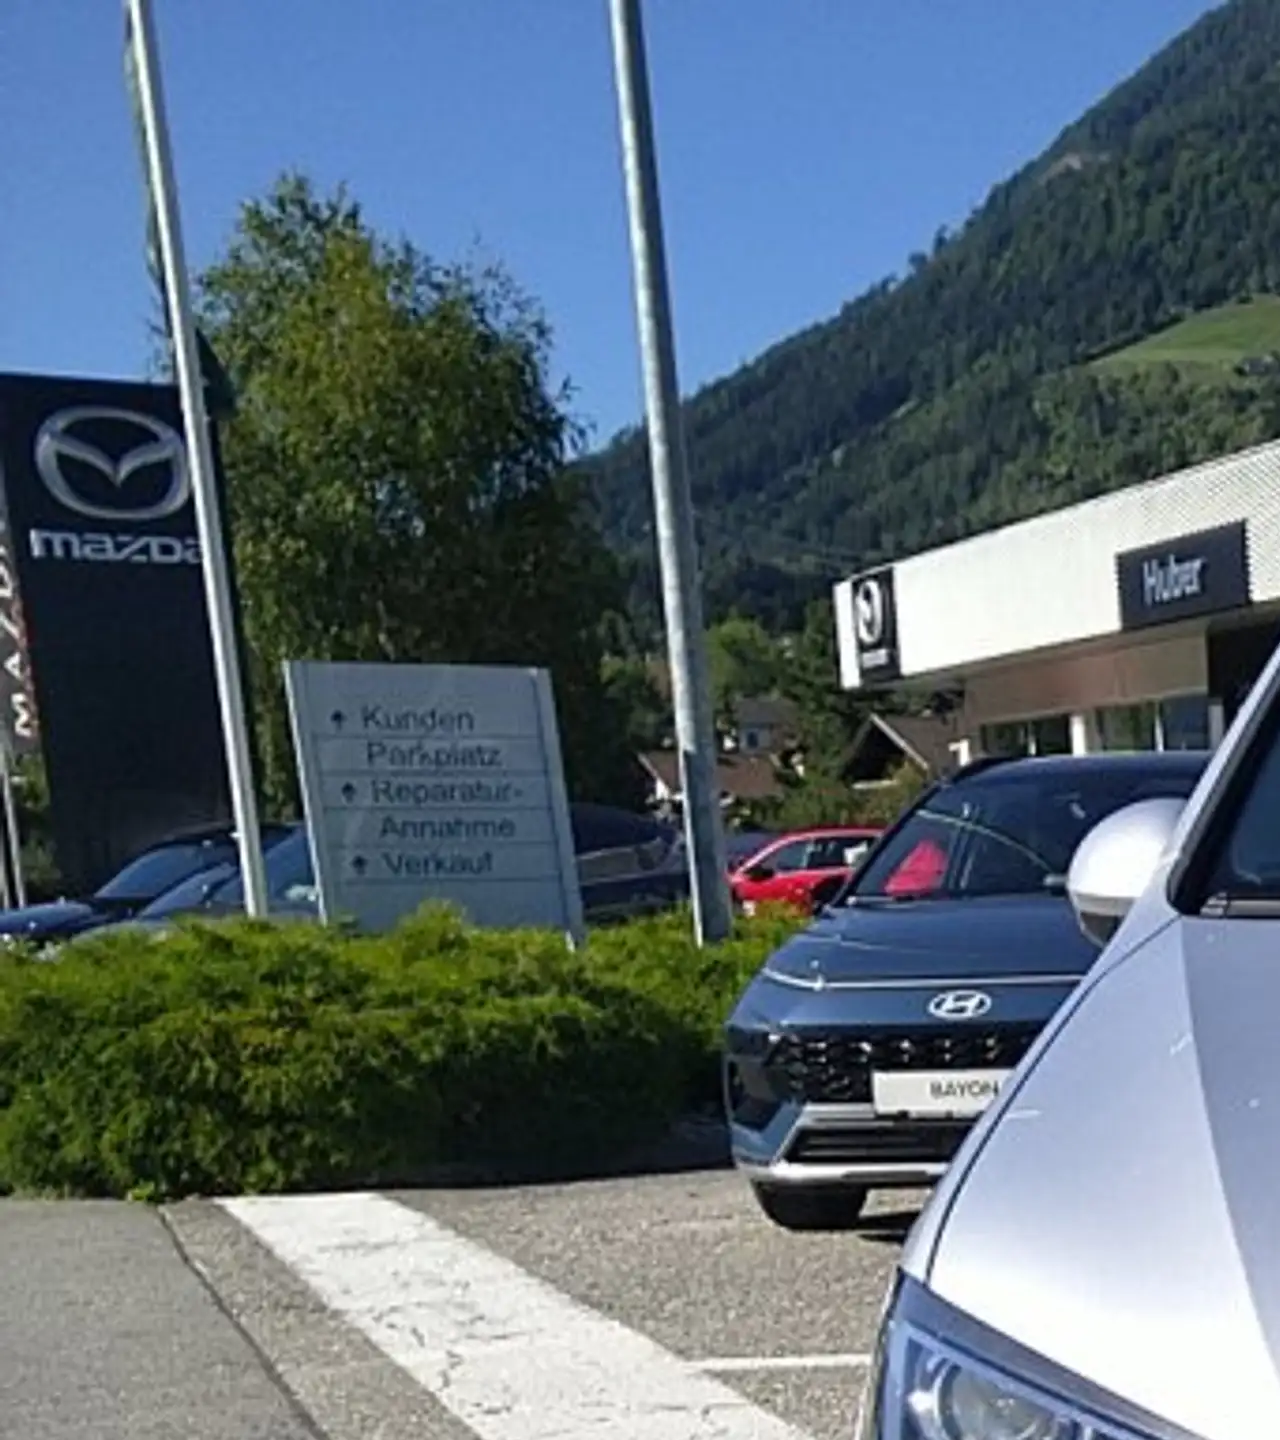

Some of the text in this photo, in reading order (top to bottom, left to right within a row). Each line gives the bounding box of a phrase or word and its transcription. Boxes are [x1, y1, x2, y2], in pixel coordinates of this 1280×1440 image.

[1143, 554, 1206, 607] Huber
[361, 704, 475, 731] Kunden
[367, 740, 503, 768] Parkplatz
[371, 779, 524, 805] Reparatur-
[379, 814, 516, 839] Annahme
[382, 851, 494, 876] Verkauf
[930, 1079, 999, 1099] BAYON
